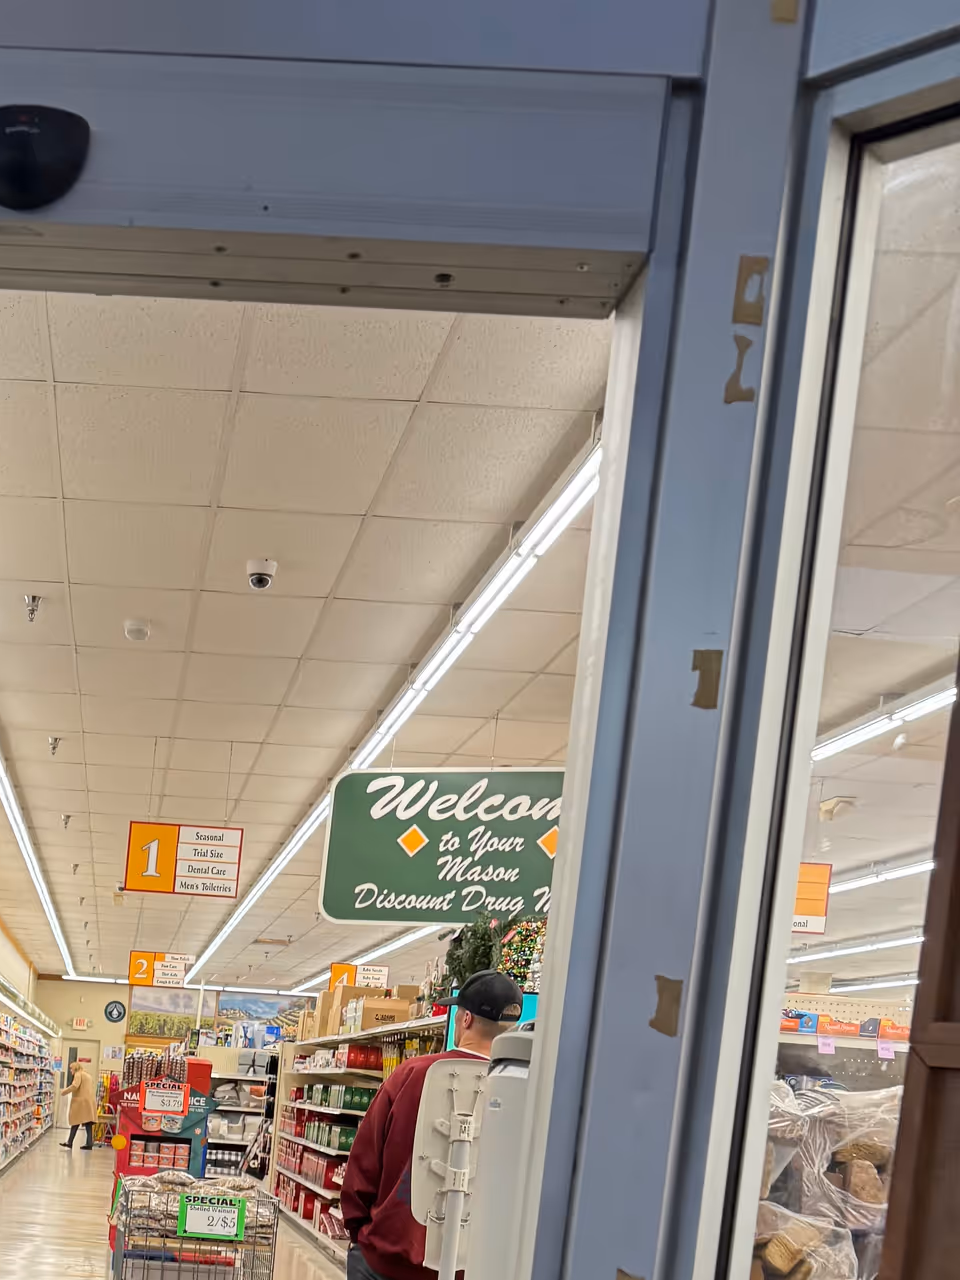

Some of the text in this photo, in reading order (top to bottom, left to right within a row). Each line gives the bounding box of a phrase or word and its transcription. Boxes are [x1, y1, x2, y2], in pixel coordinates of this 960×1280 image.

[195, 831, 224, 842] Seasonal
[438, 825, 525, 860] to Your
[141, 838, 161, 878] 1
[192, 848, 224, 859] Trial Size
[187, 864, 227, 876] Dental Care
[436, 854, 520, 883] Mason
[179, 880, 232, 893] Men's Toiletries
[353, 882, 456, 912] Discount
[461, 884, 525, 920] Drug
[793, 919, 809, 929] onal
[133, 958, 148, 979] 2
[334, 971, 348, 986] 4
[160, 1098, 182, 1108] $3.79
[189, 1205, 236, 1214] Shelled Walnuts
[206, 1215, 236, 1229] 2/$5
